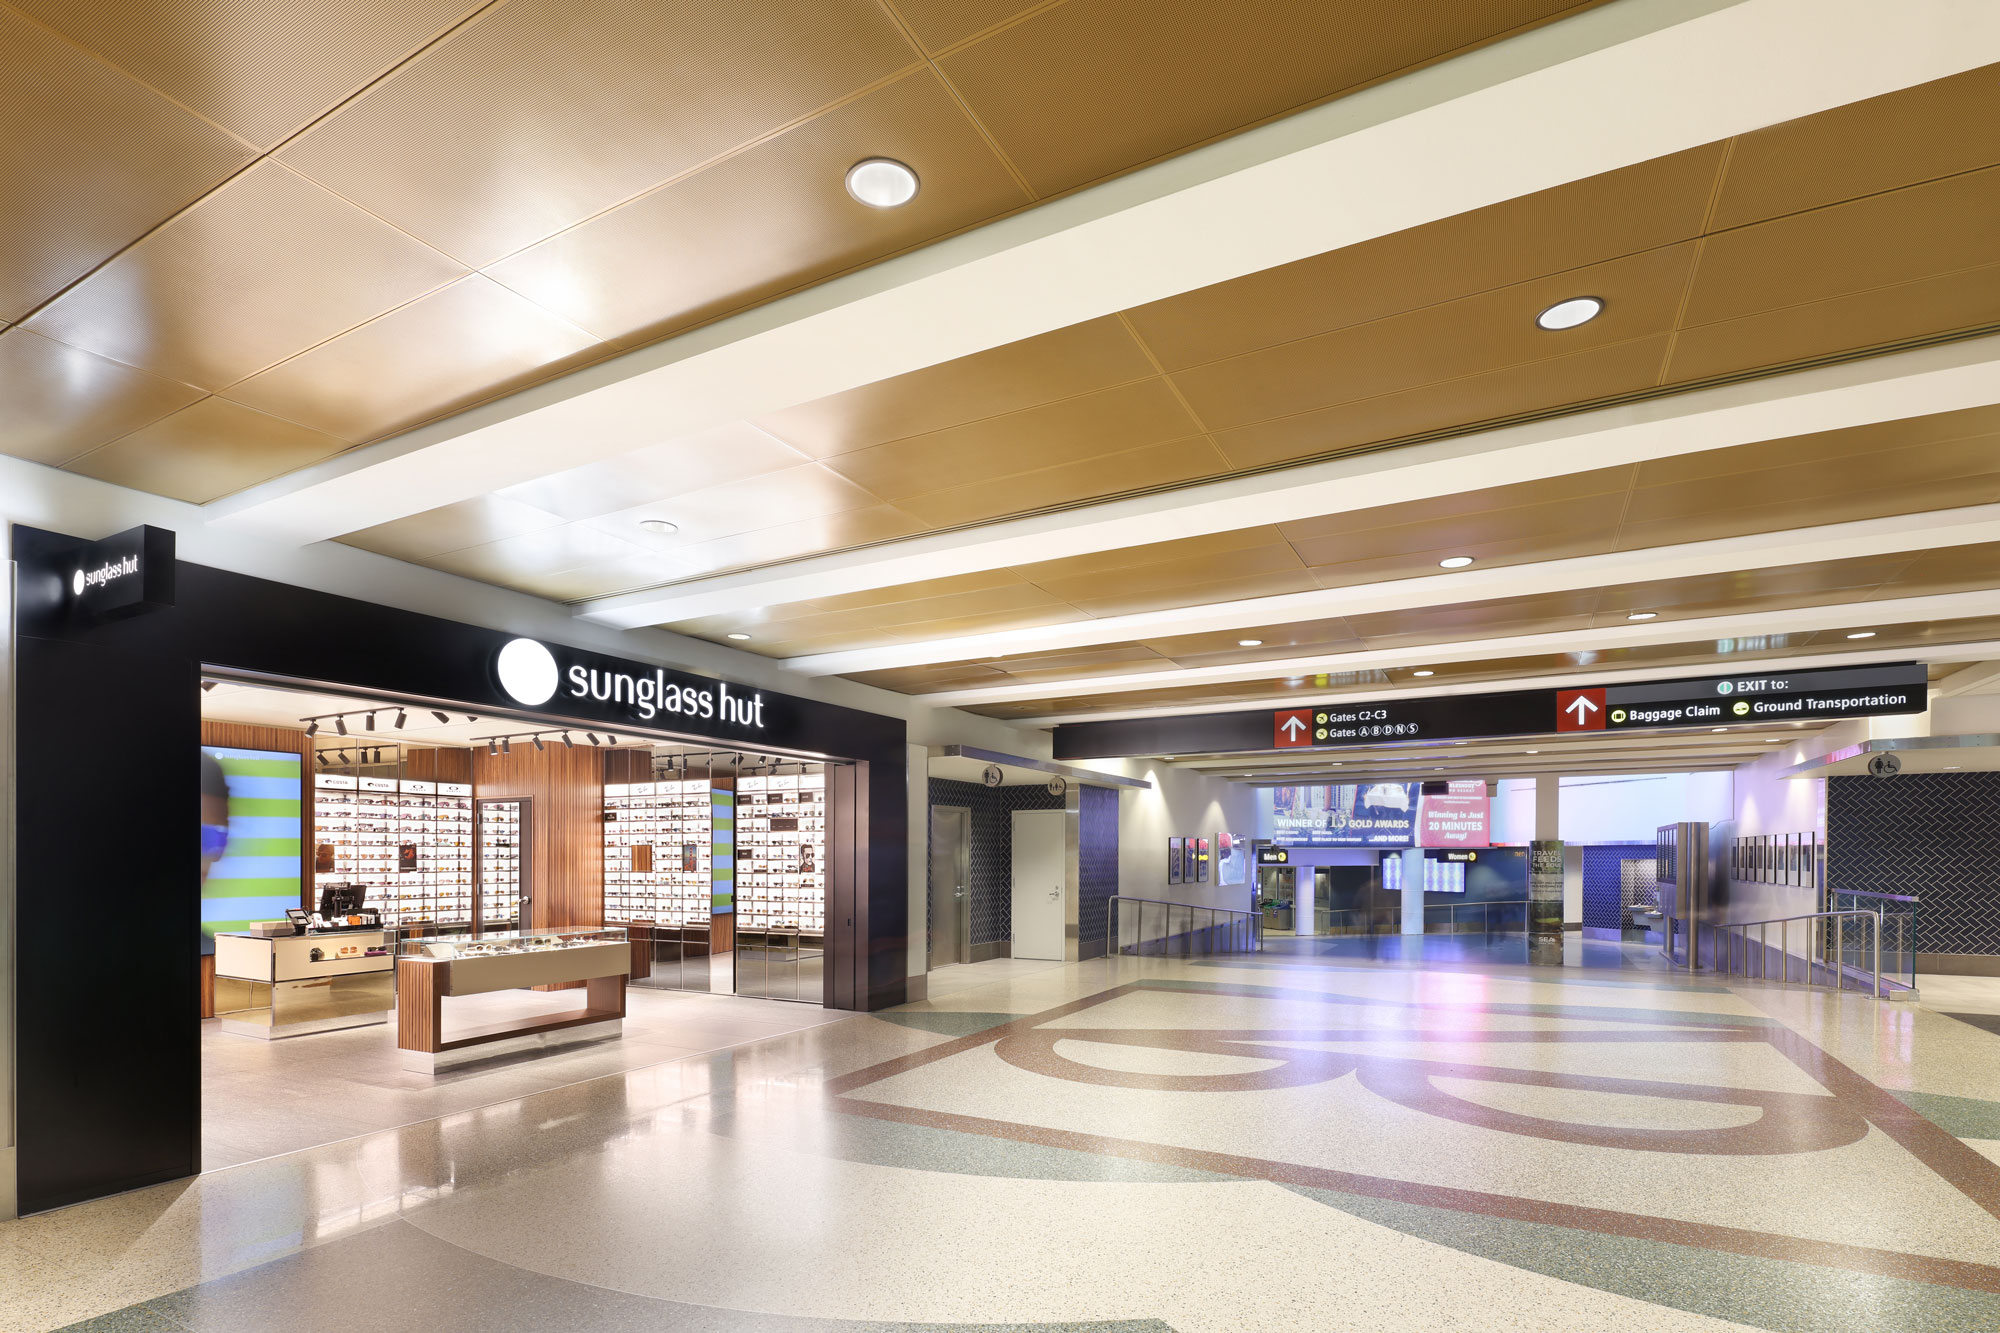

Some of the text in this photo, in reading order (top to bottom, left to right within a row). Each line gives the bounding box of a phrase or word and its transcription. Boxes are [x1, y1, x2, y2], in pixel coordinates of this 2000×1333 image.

[86, 555, 138, 587] sunglass hut
[1737, 679, 1789, 692] EXIT to:
[569, 665, 764, 728] sunglass hut
[1753, 694, 1907, 714] Ground Transportation
[1329, 710, 1387, 723] Gates C2-C3
[1630, 704, 1721, 722] Baggage Claim
[1329, 728, 1357, 738] Gates
[1277, 819, 1313, 828] WINNER
[1314, 819, 1327, 828] OF
[1348, 819, 1372, 828] GOLD
[1373, 819, 1409, 829] AWARDS
[1428, 821, 1483, 831] 20 MINUTES
